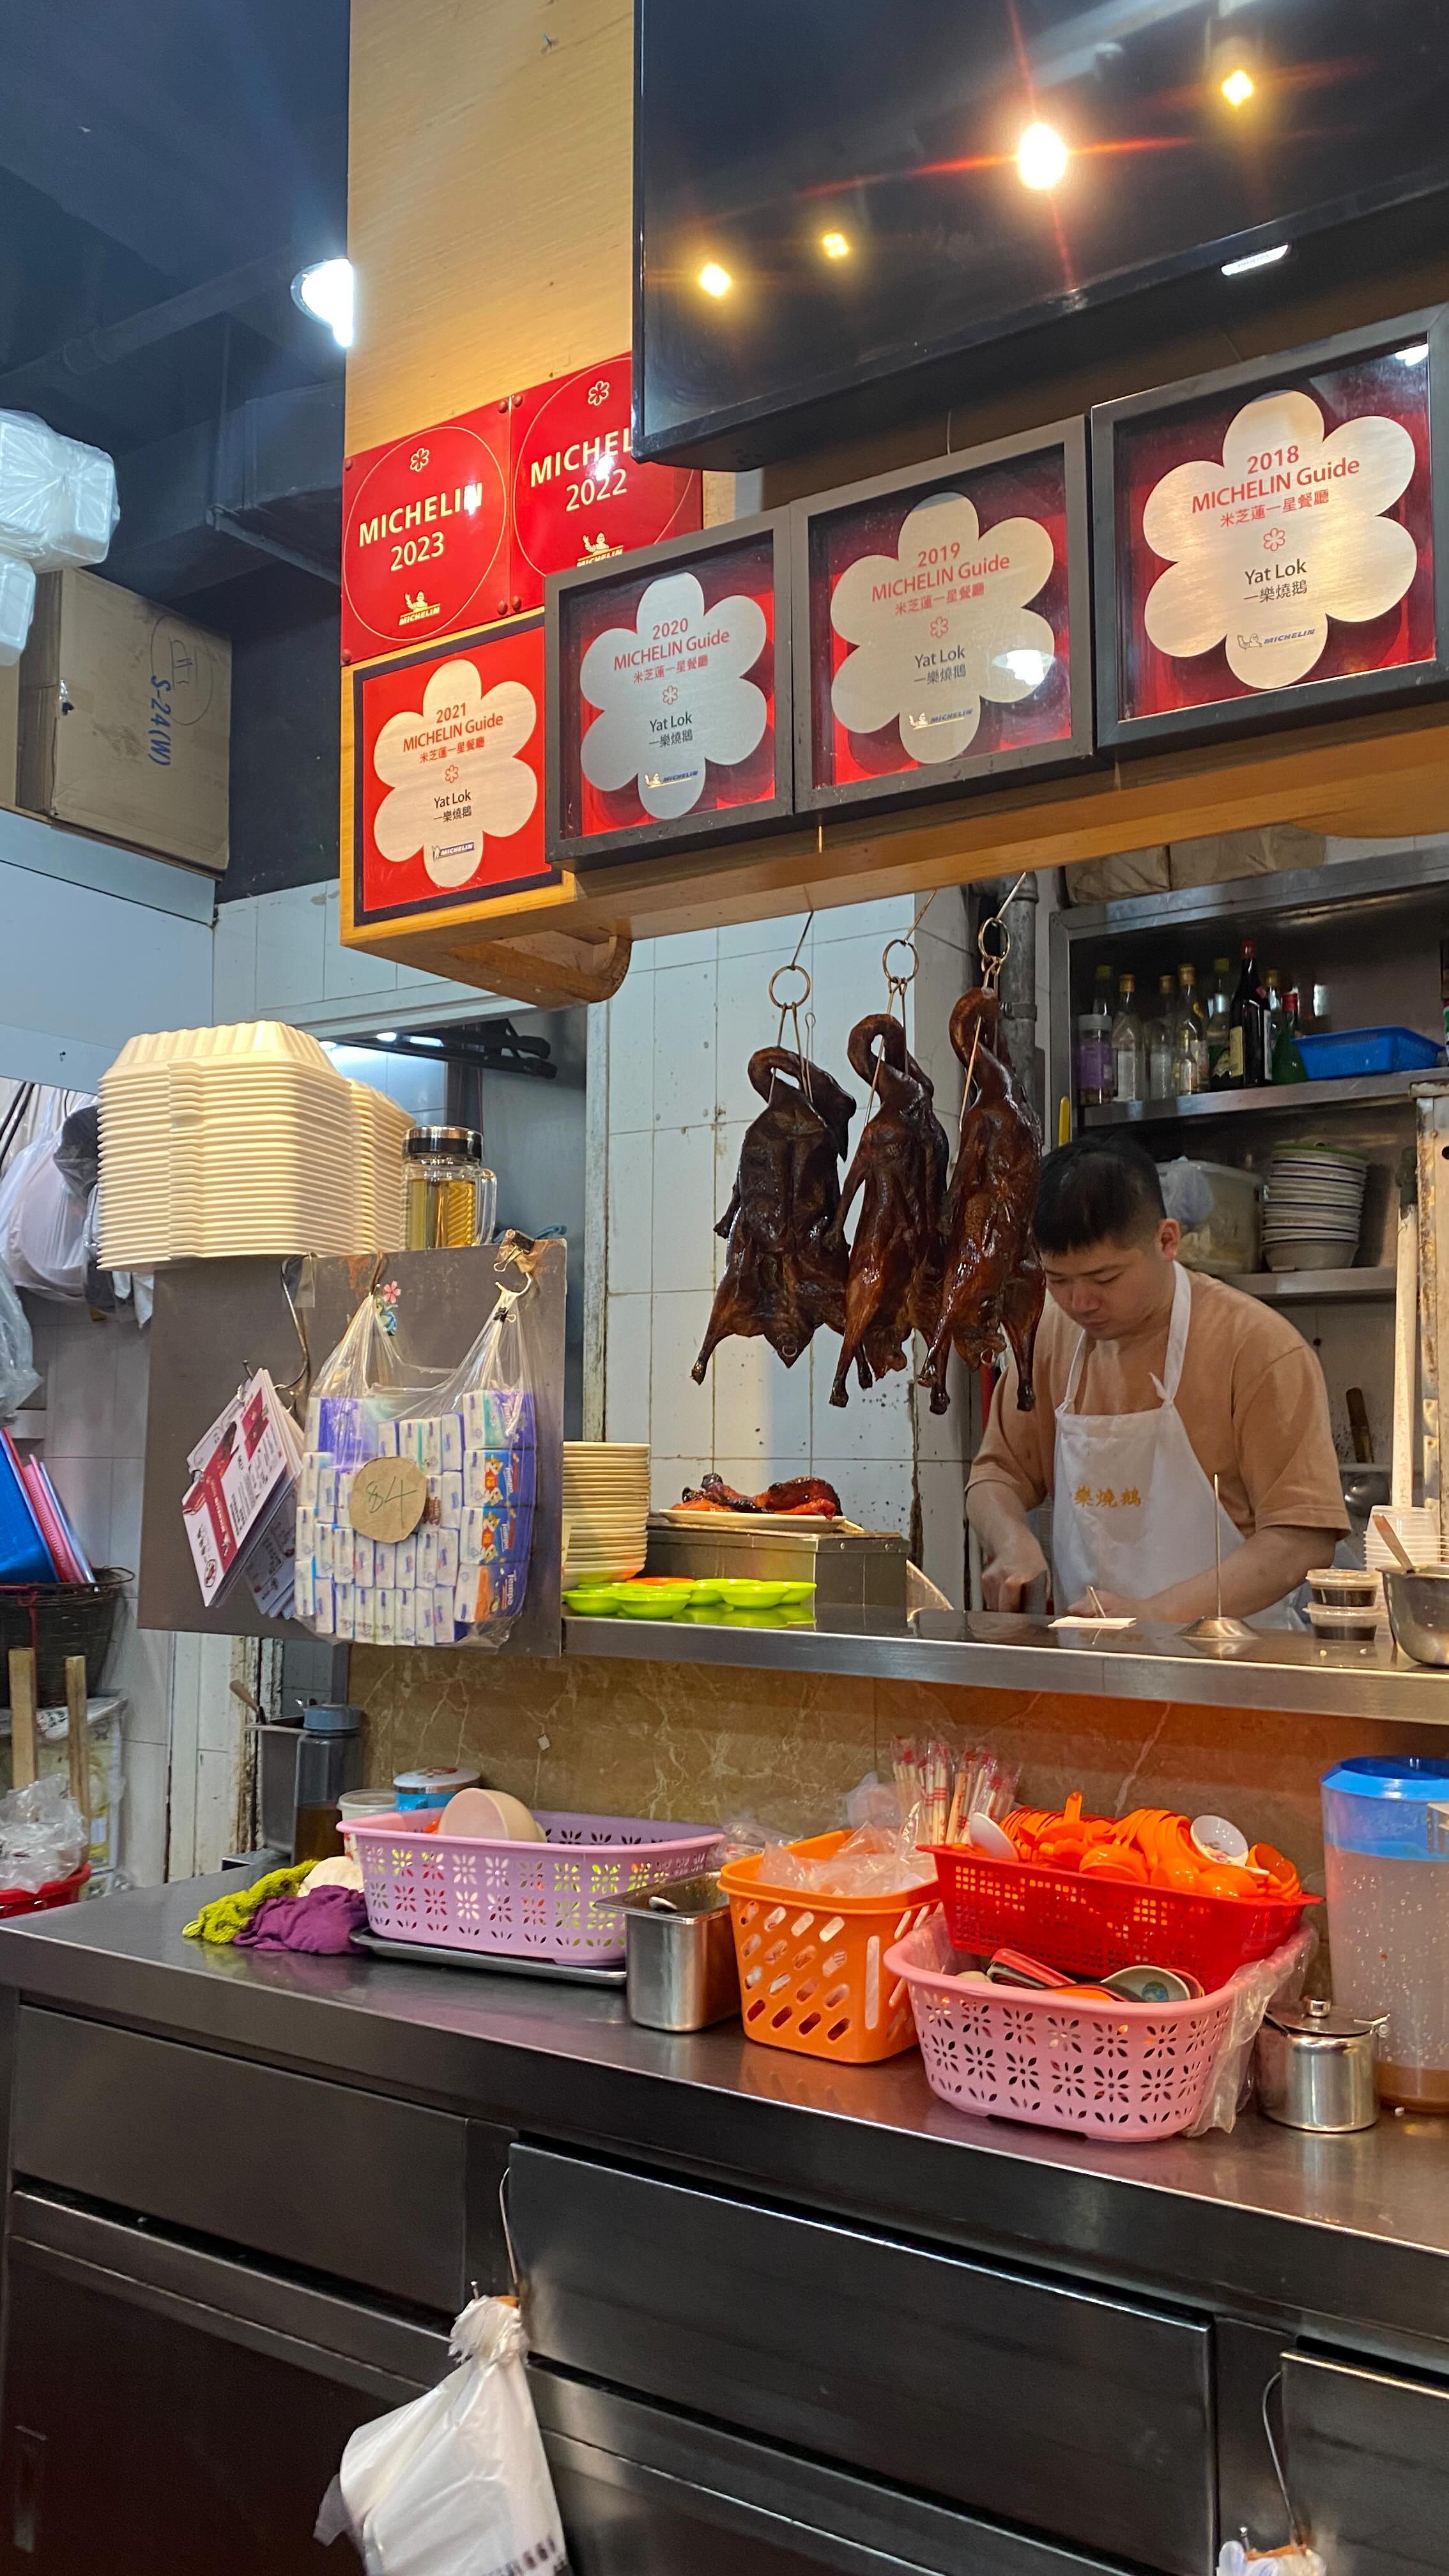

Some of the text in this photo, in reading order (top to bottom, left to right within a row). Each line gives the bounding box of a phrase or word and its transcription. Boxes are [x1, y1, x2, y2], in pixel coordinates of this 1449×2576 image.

[531, 427, 632, 488] MICHEL
[1247, 445, 1300, 474] 2018
[565, 468, 628, 512] 2022
[1192, 457, 1360, 514] MICHELIN Guide
[358, 482, 483, 548] MICHELIN
[1220, 489, 1330, 527] 米芝蓮一星餐廳
[390, 531, 445, 572] 2023
[917, 542, 961, 568] 2019
[871, 554, 1011, 602] MICHELIN Guide
[1244, 559, 1307, 585] Yat Lok
[894, 582, 985, 617] 米芝蓮一星餐廳
[1243, 579, 1308, 604] 一樂燒鵝
[398, 606, 441, 626] MICHELIN
[652, 617, 689, 641] 2020
[1264, 628, 1316, 645] MICHELIN
[613, 629, 730, 671] MICHELIN Guide
[914, 645, 966, 669] Yat Lok
[632, 654, 709, 684] 米芝蓮一星餐廳
[913, 664, 967, 686] 一樂燒鵝
[436, 702, 467, 724] 2021
[649, 710, 693, 733] Yat Lok
[930, 708, 974, 723] MICHELIN
[402, 712, 504, 753] MICHELIN Guide
[648, 728, 694, 749] 一樂燒鵝
[419, 735, 486, 764] 米芝蓮一星餐廳
[663, 769, 699, 784] MICHELIN
[433, 789, 472, 809] Yat Lok
[433, 805, 473, 823] 一樂燒鵝
[440, 842, 474, 857] MICHELIN
